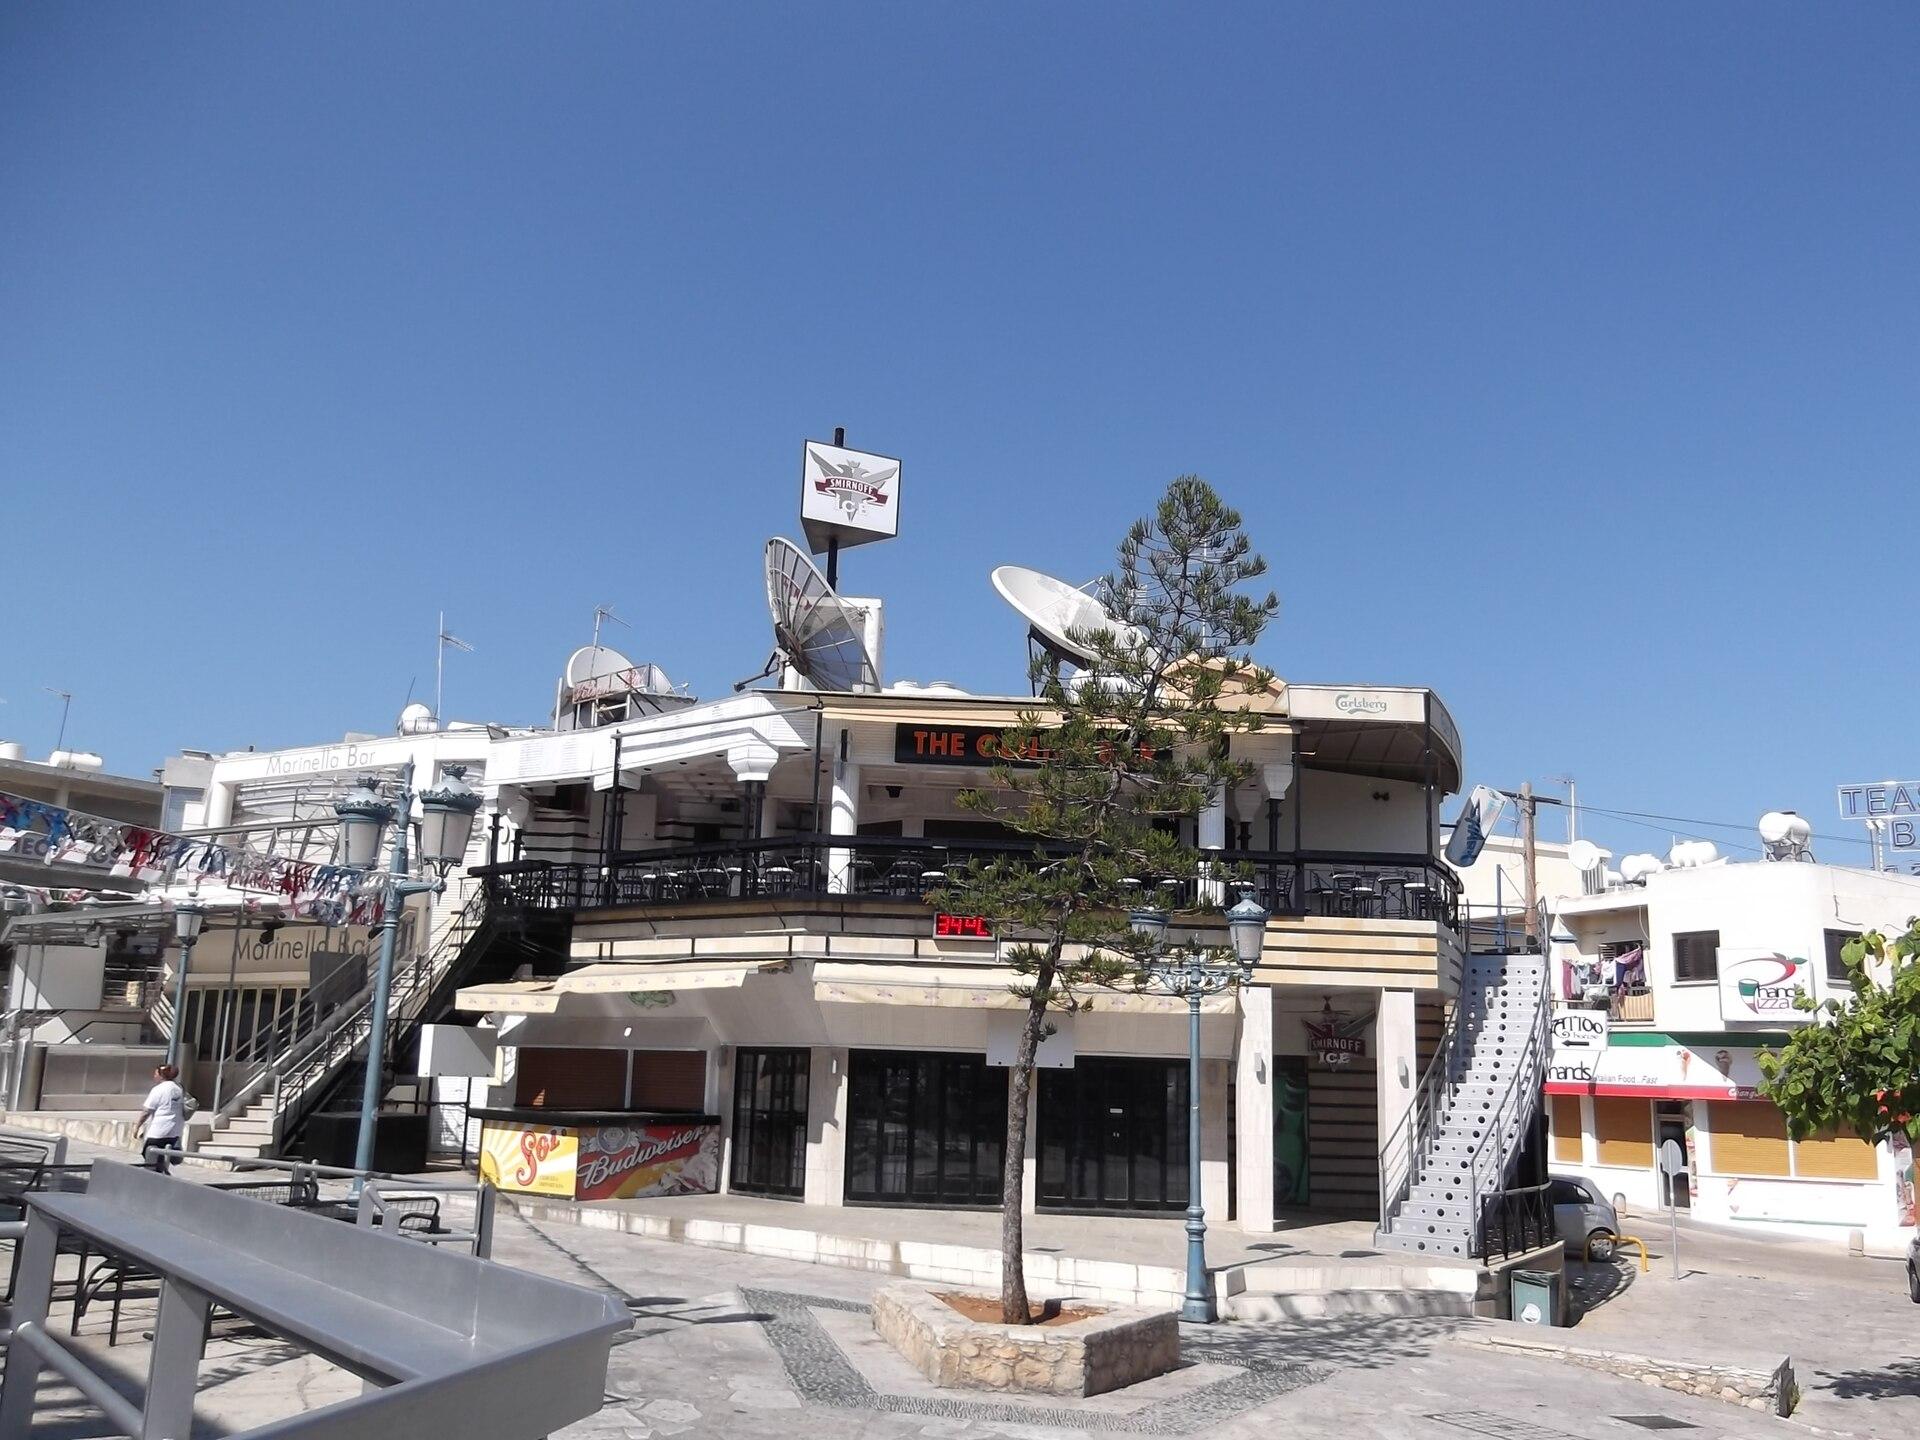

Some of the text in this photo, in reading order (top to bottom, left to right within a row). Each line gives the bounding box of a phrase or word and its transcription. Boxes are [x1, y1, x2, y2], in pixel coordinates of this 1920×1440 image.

[829, 478, 874, 496] SMIRNOFF
[1335, 694, 1387, 713] Carlsberg
[914, 731, 965, 757] THE
[266, 744, 376, 776] Marinella Bar
[1841, 785, 1920, 815] TEA
[1311, 1038, 1361, 1053] SMIRNOFF
[516, 1129, 561, 1187] Sol
[576, 1126, 706, 1190] Budweiser
